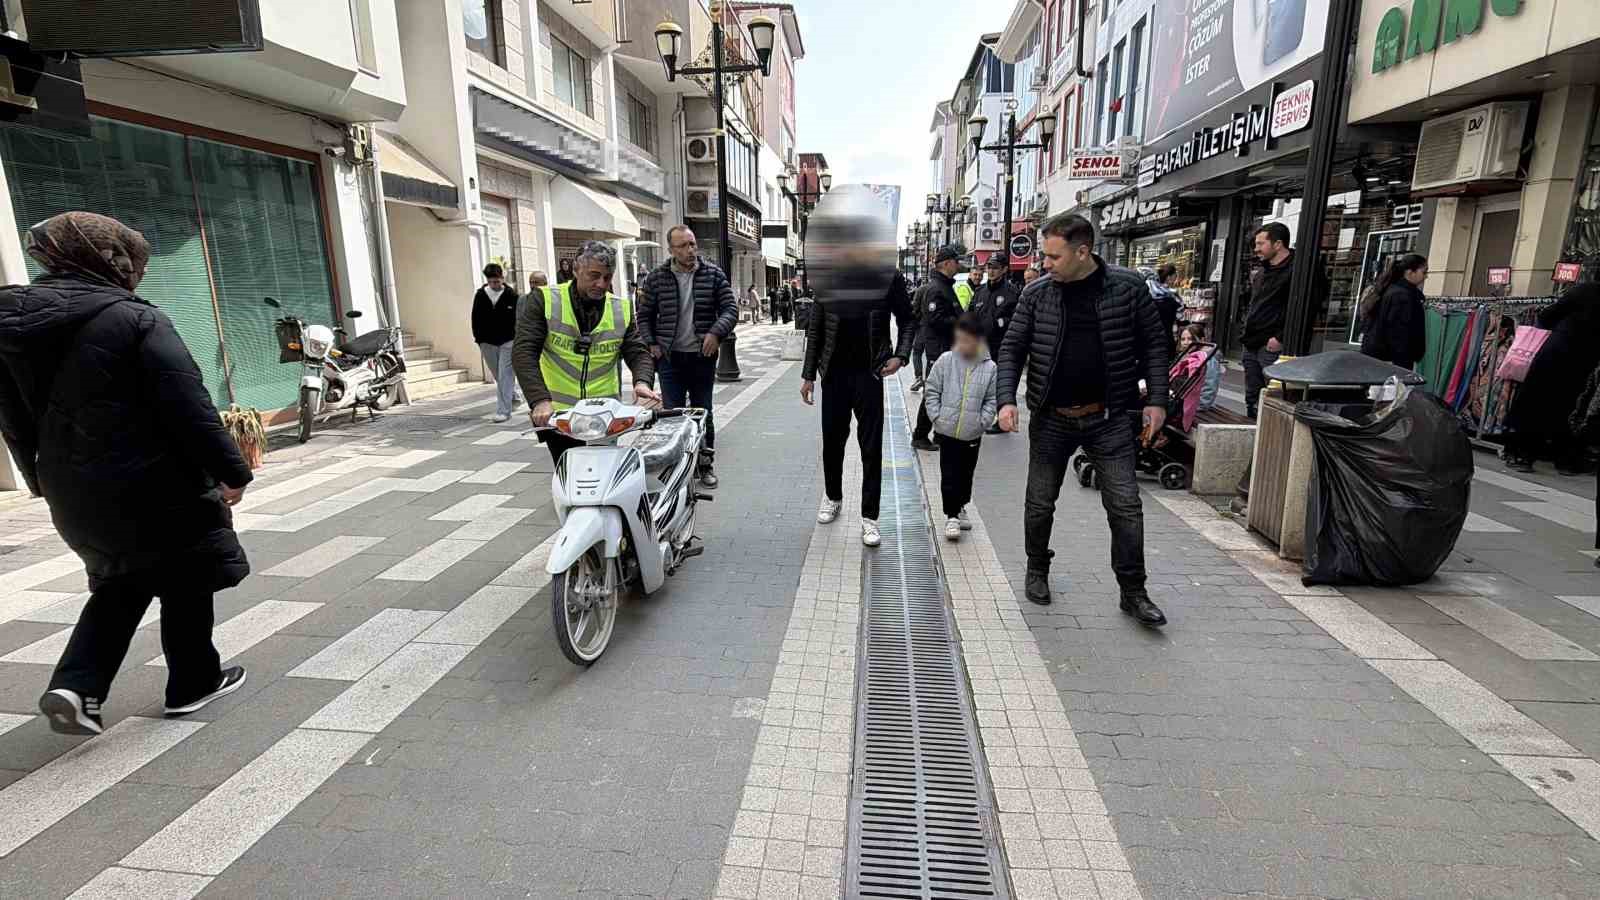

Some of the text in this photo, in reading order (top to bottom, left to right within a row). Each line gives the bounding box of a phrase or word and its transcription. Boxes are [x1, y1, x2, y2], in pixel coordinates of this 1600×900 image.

[1276, 88, 1311, 113] TEKNİK
[1274, 105, 1308, 128] SERVİS
[1197, 103, 1266, 160] İLETİŞİM
